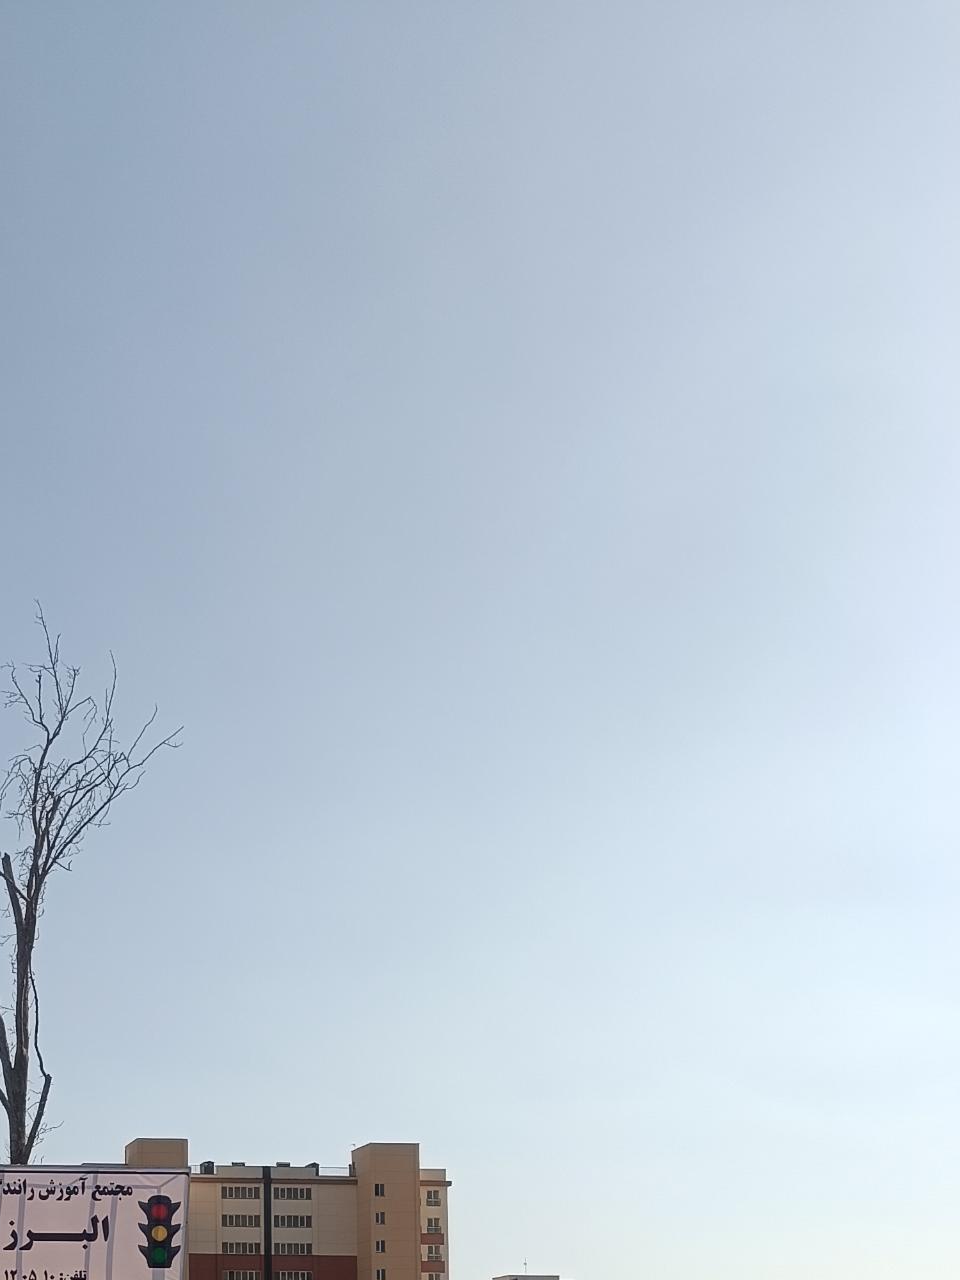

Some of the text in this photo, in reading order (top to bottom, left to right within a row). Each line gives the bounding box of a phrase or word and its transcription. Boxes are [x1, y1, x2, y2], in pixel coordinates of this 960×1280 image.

[38, 1177, 88, 1201] آموزش
[92, 1179, 133, 1201] مجتمع
[3, 1214, 110, 1251] البرز
